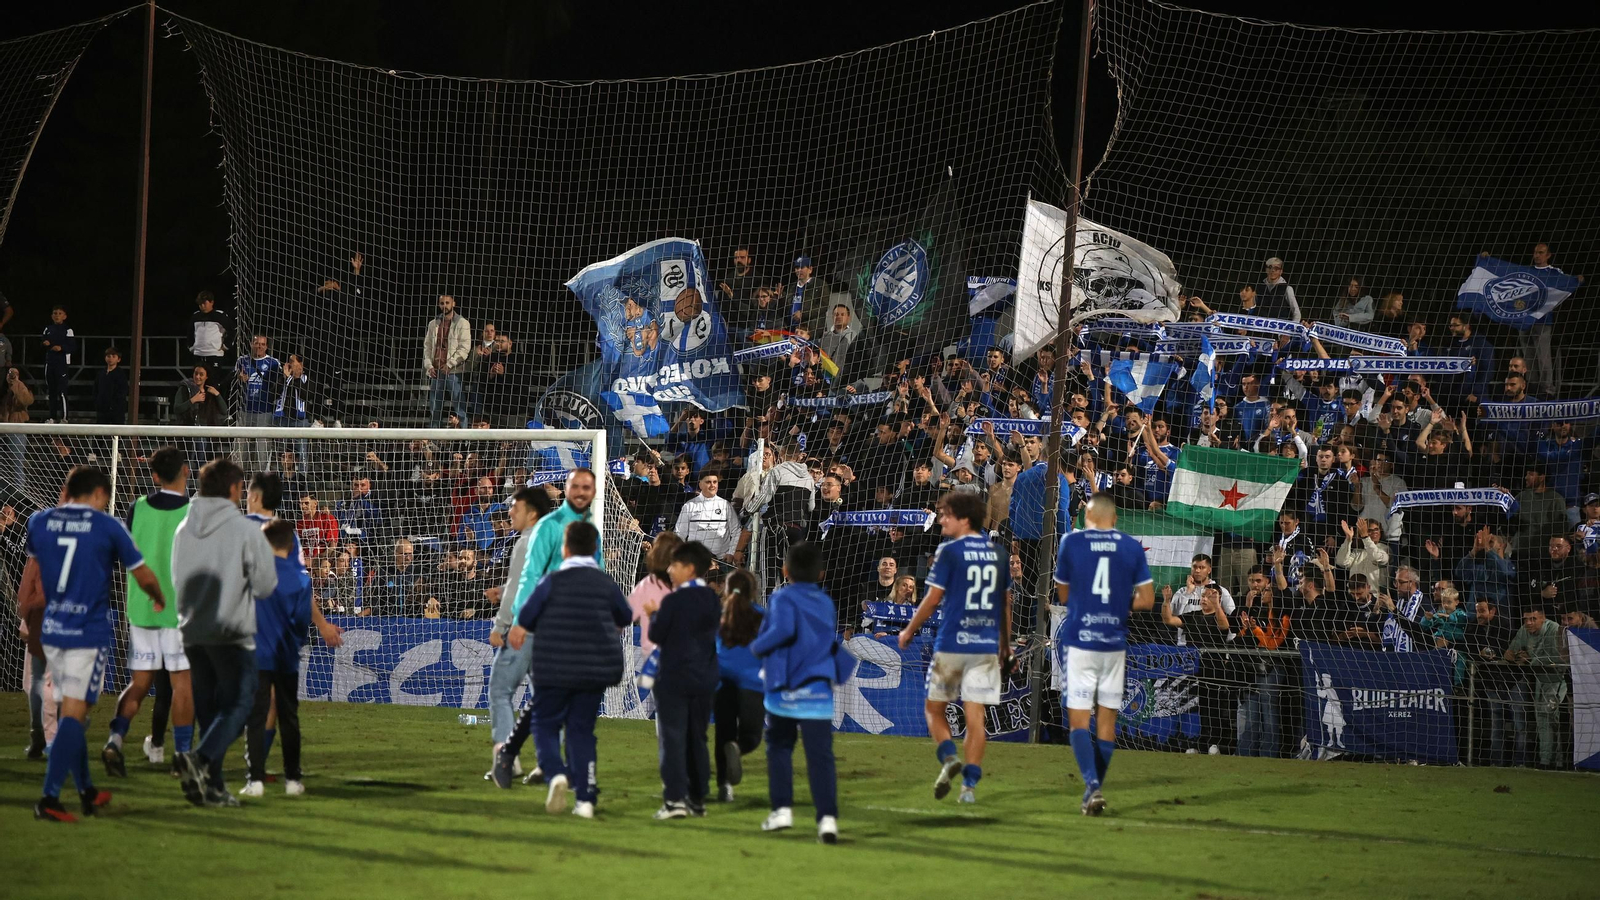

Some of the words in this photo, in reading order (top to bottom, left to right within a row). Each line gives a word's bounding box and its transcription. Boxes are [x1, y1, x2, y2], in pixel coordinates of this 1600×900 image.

[1216, 314, 1303, 333] XERECISTAS
[1325, 329, 1348, 341] DONDE
[1349, 333, 1372, 346] VAYAS
[1374, 339, 1383, 348] YO
[1385, 341, 1394, 350] TE
[1286, 359, 1325, 369] FORZA
[1363, 360, 1458, 370] XERECISTAS
[850, 391, 891, 404] XEREZ
[1488, 404, 1523, 419] XEREZ
[1525, 402, 1588, 418] DEPORTIVO
[1413, 492, 1440, 502] DONDE
[1442, 491, 1469, 501] VAYAS
[1471, 490, 1483, 500] YO
[1484, 490, 1494, 500] TE
[1090, 541, 1117, 552] HUGO
[57, 537, 77, 593] 7
[965, 564, 998, 610] 22
[1091, 556, 1111, 604] 4
